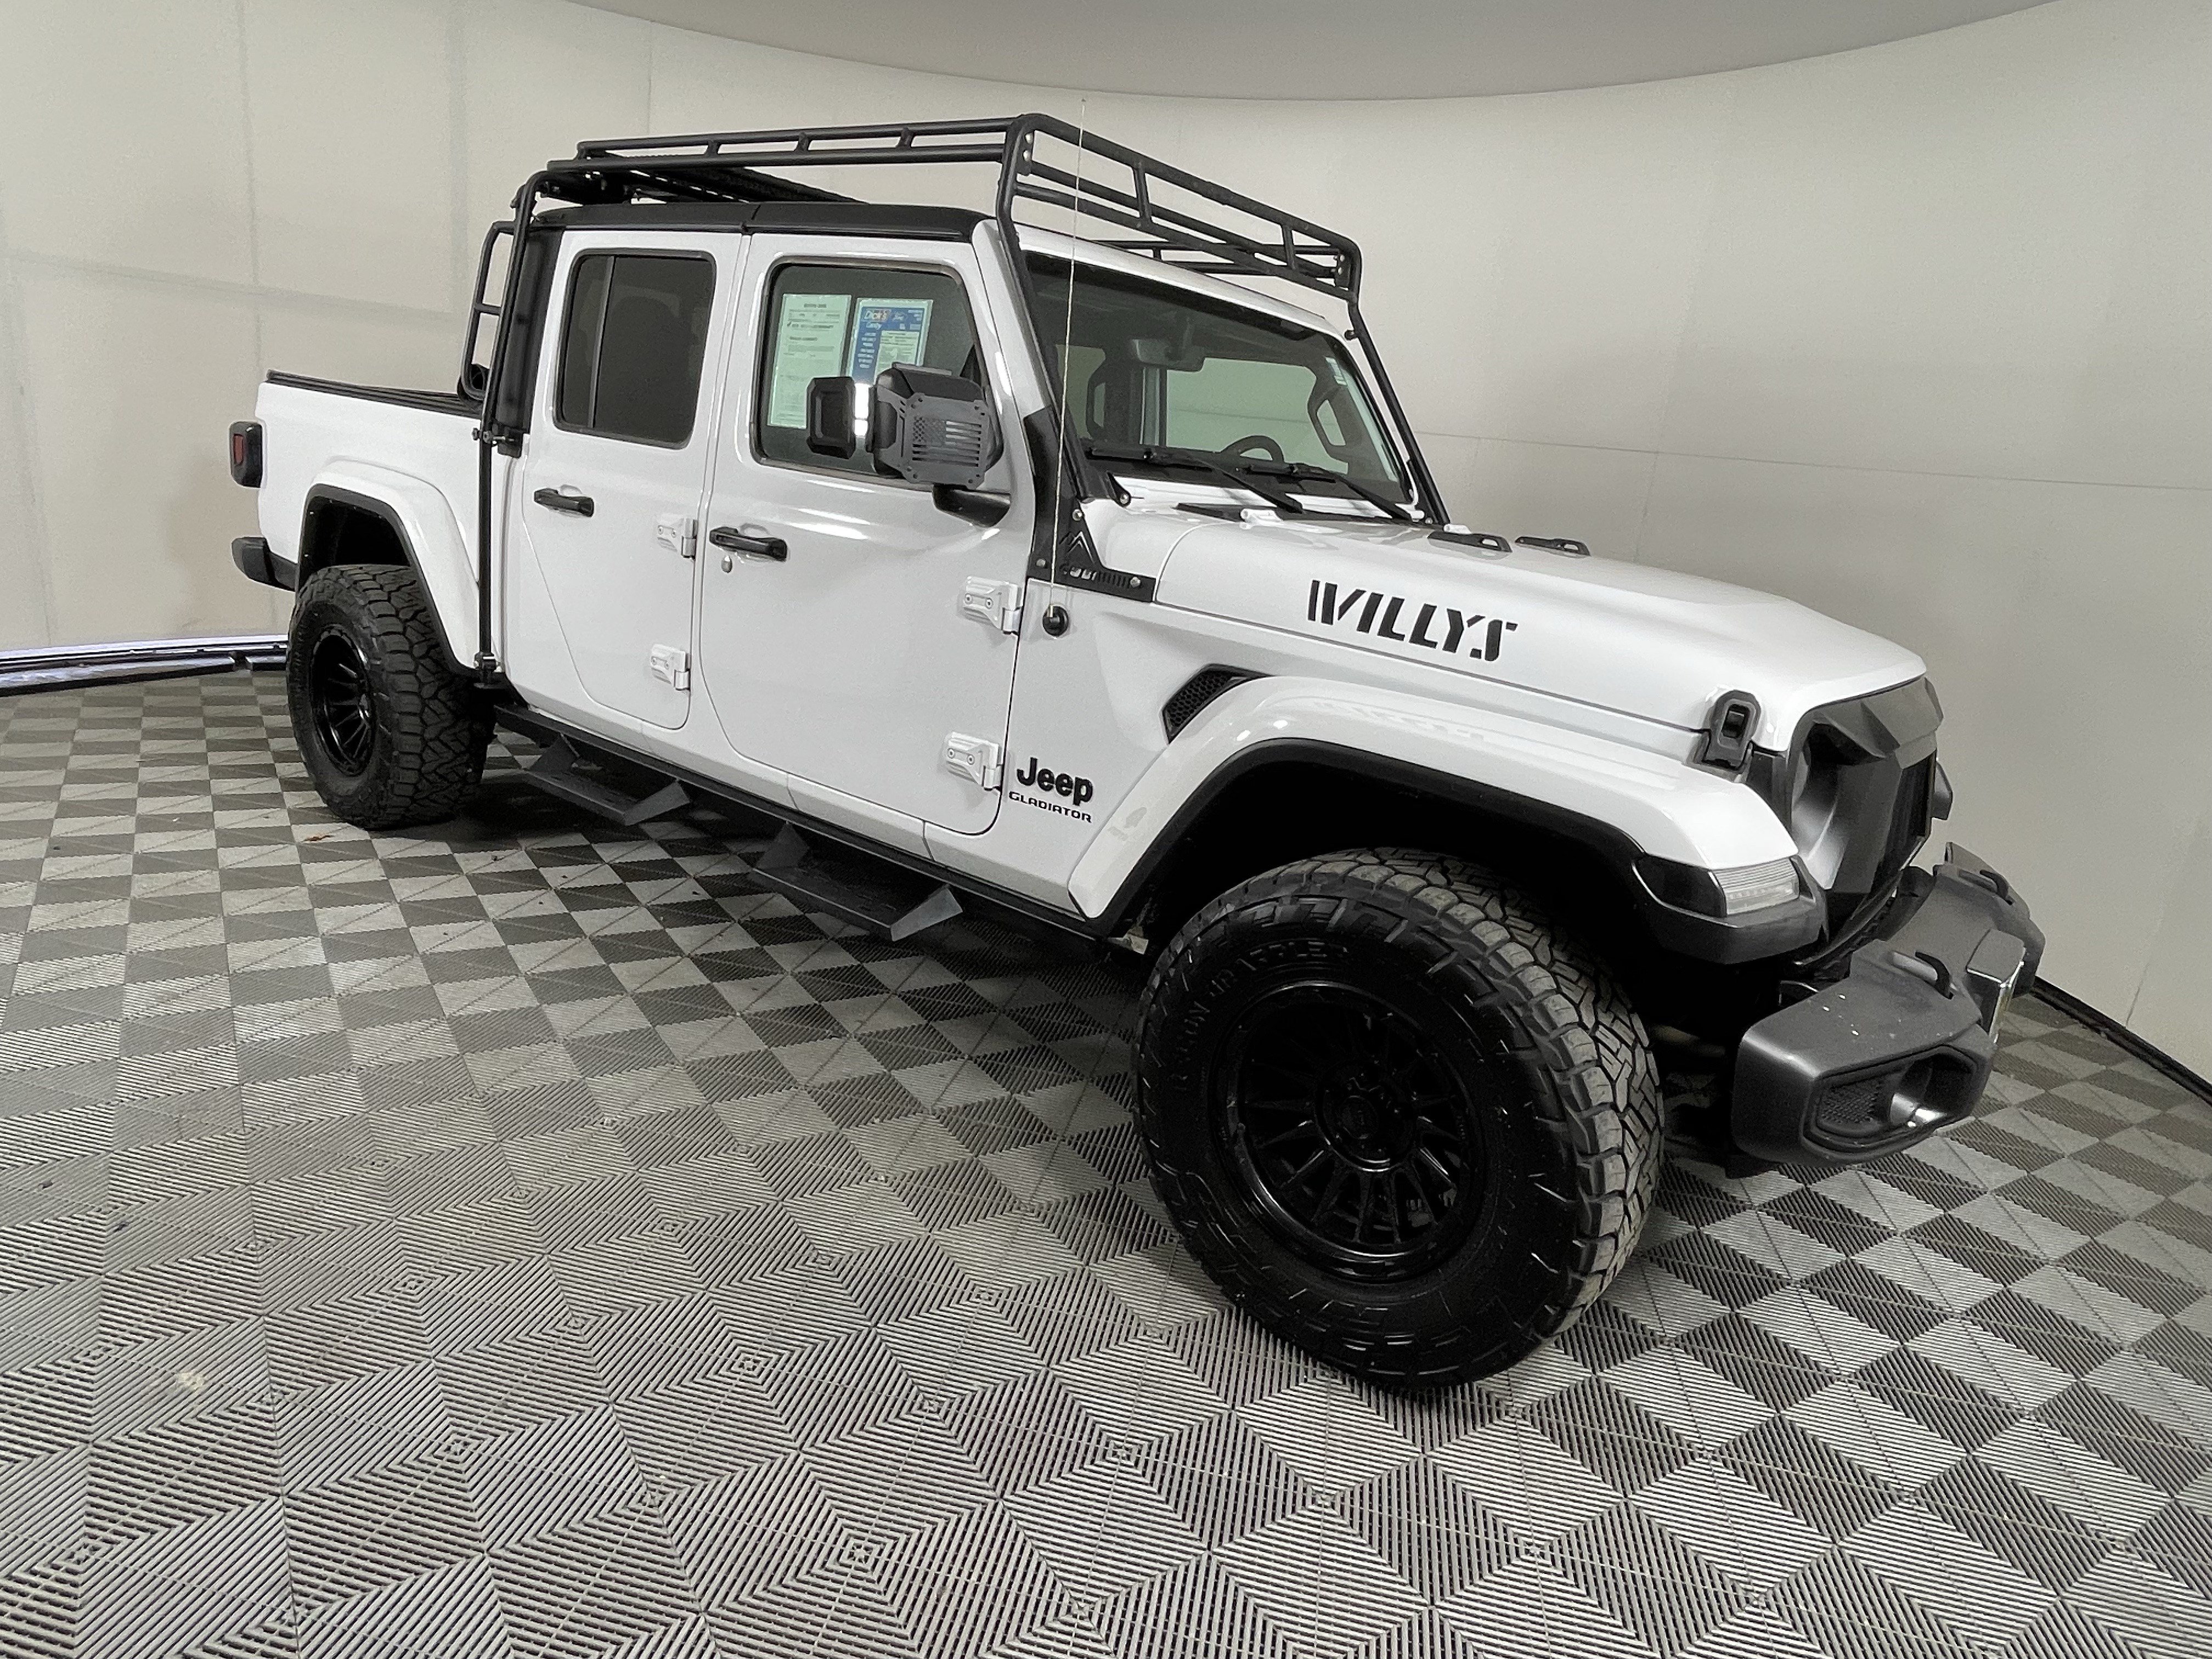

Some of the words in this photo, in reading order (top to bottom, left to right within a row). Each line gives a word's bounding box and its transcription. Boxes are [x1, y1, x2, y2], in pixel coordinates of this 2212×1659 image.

[1308, 580, 1518, 661] WILLYS
[1017, 757, 1093, 806] Jeep
[1008, 791, 1092, 823] GLADIATOR
